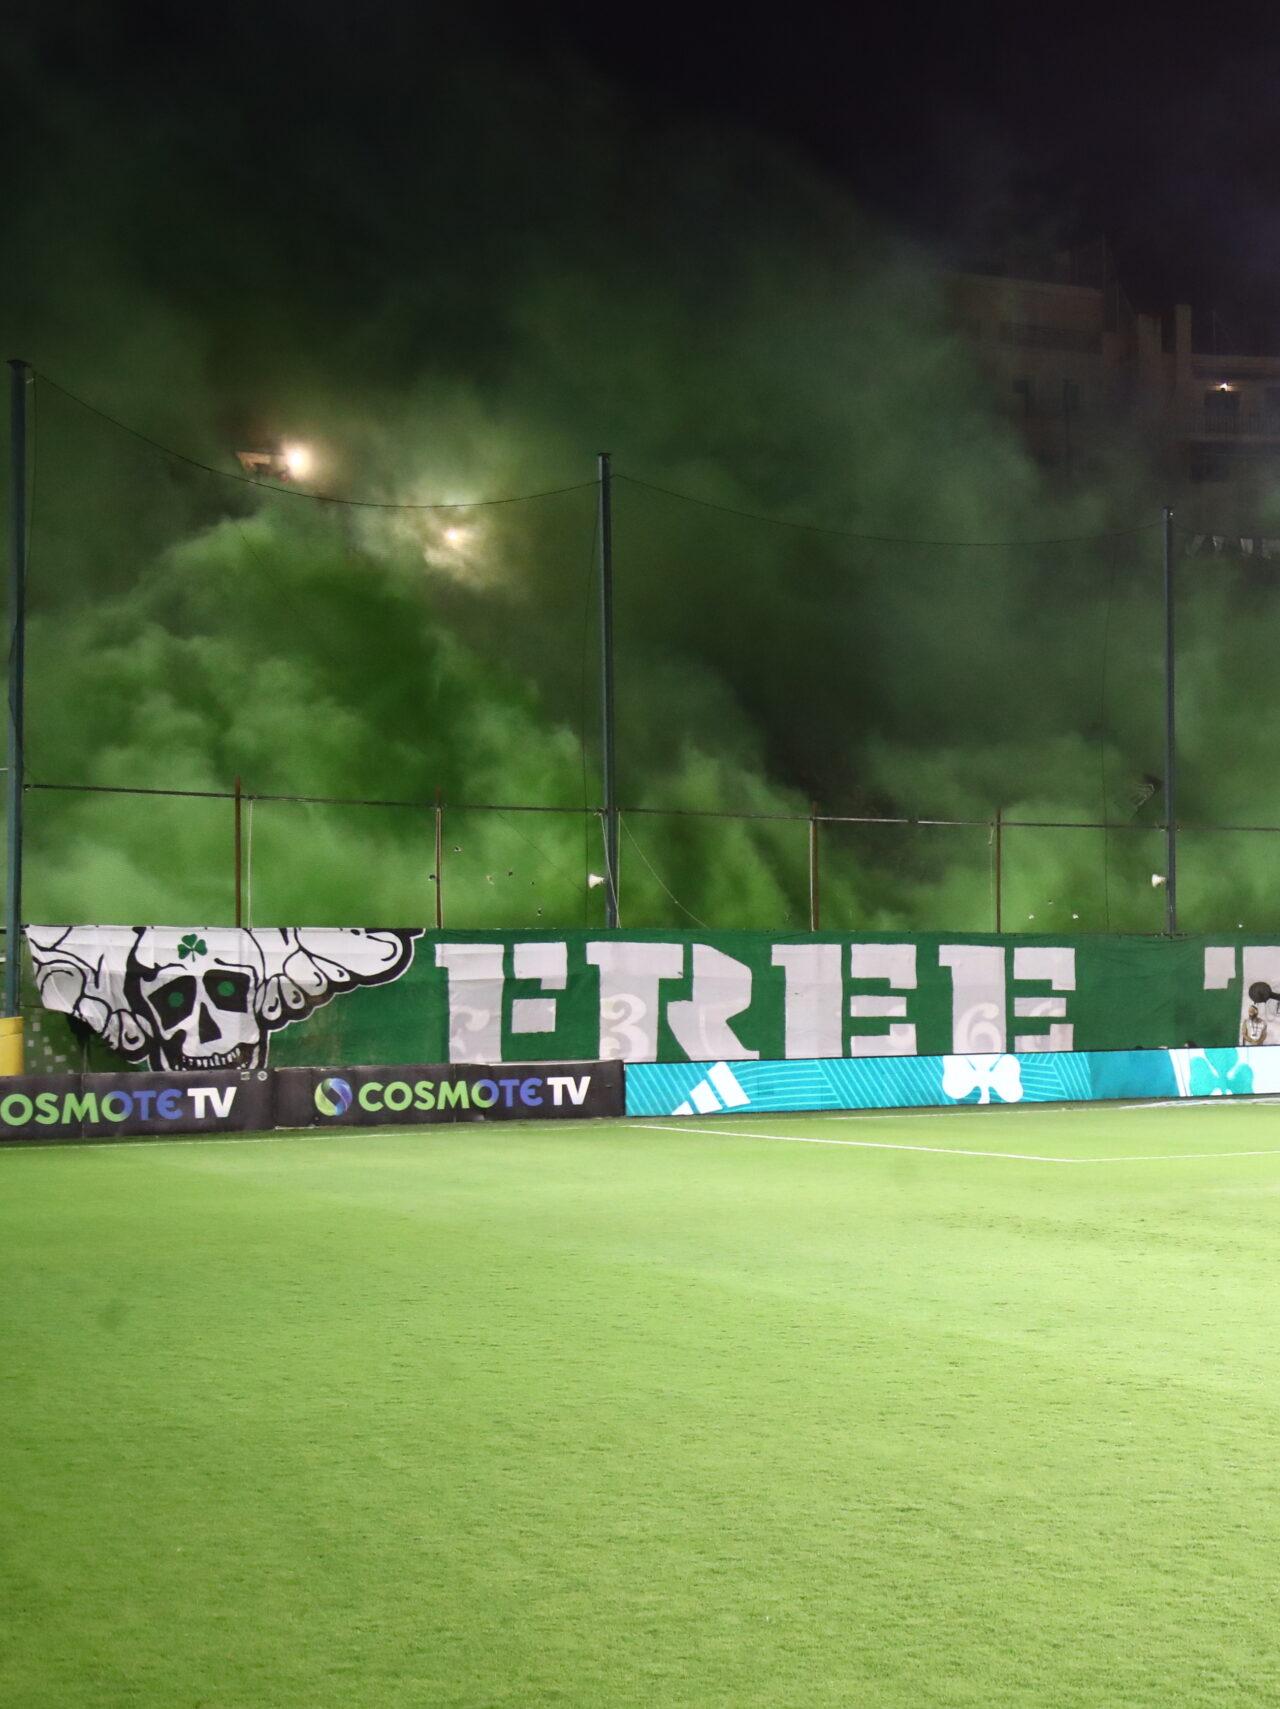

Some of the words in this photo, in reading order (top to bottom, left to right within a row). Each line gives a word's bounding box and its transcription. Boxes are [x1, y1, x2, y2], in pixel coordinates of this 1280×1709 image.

[435, 943, 1075, 1063] FREE
[0, 1090, 183, 1126] OSMOTE
[187, 1087, 237, 1120] TV
[358, 1078, 543, 1112] COSMOTE
[546, 1076, 591, 1106] TV
